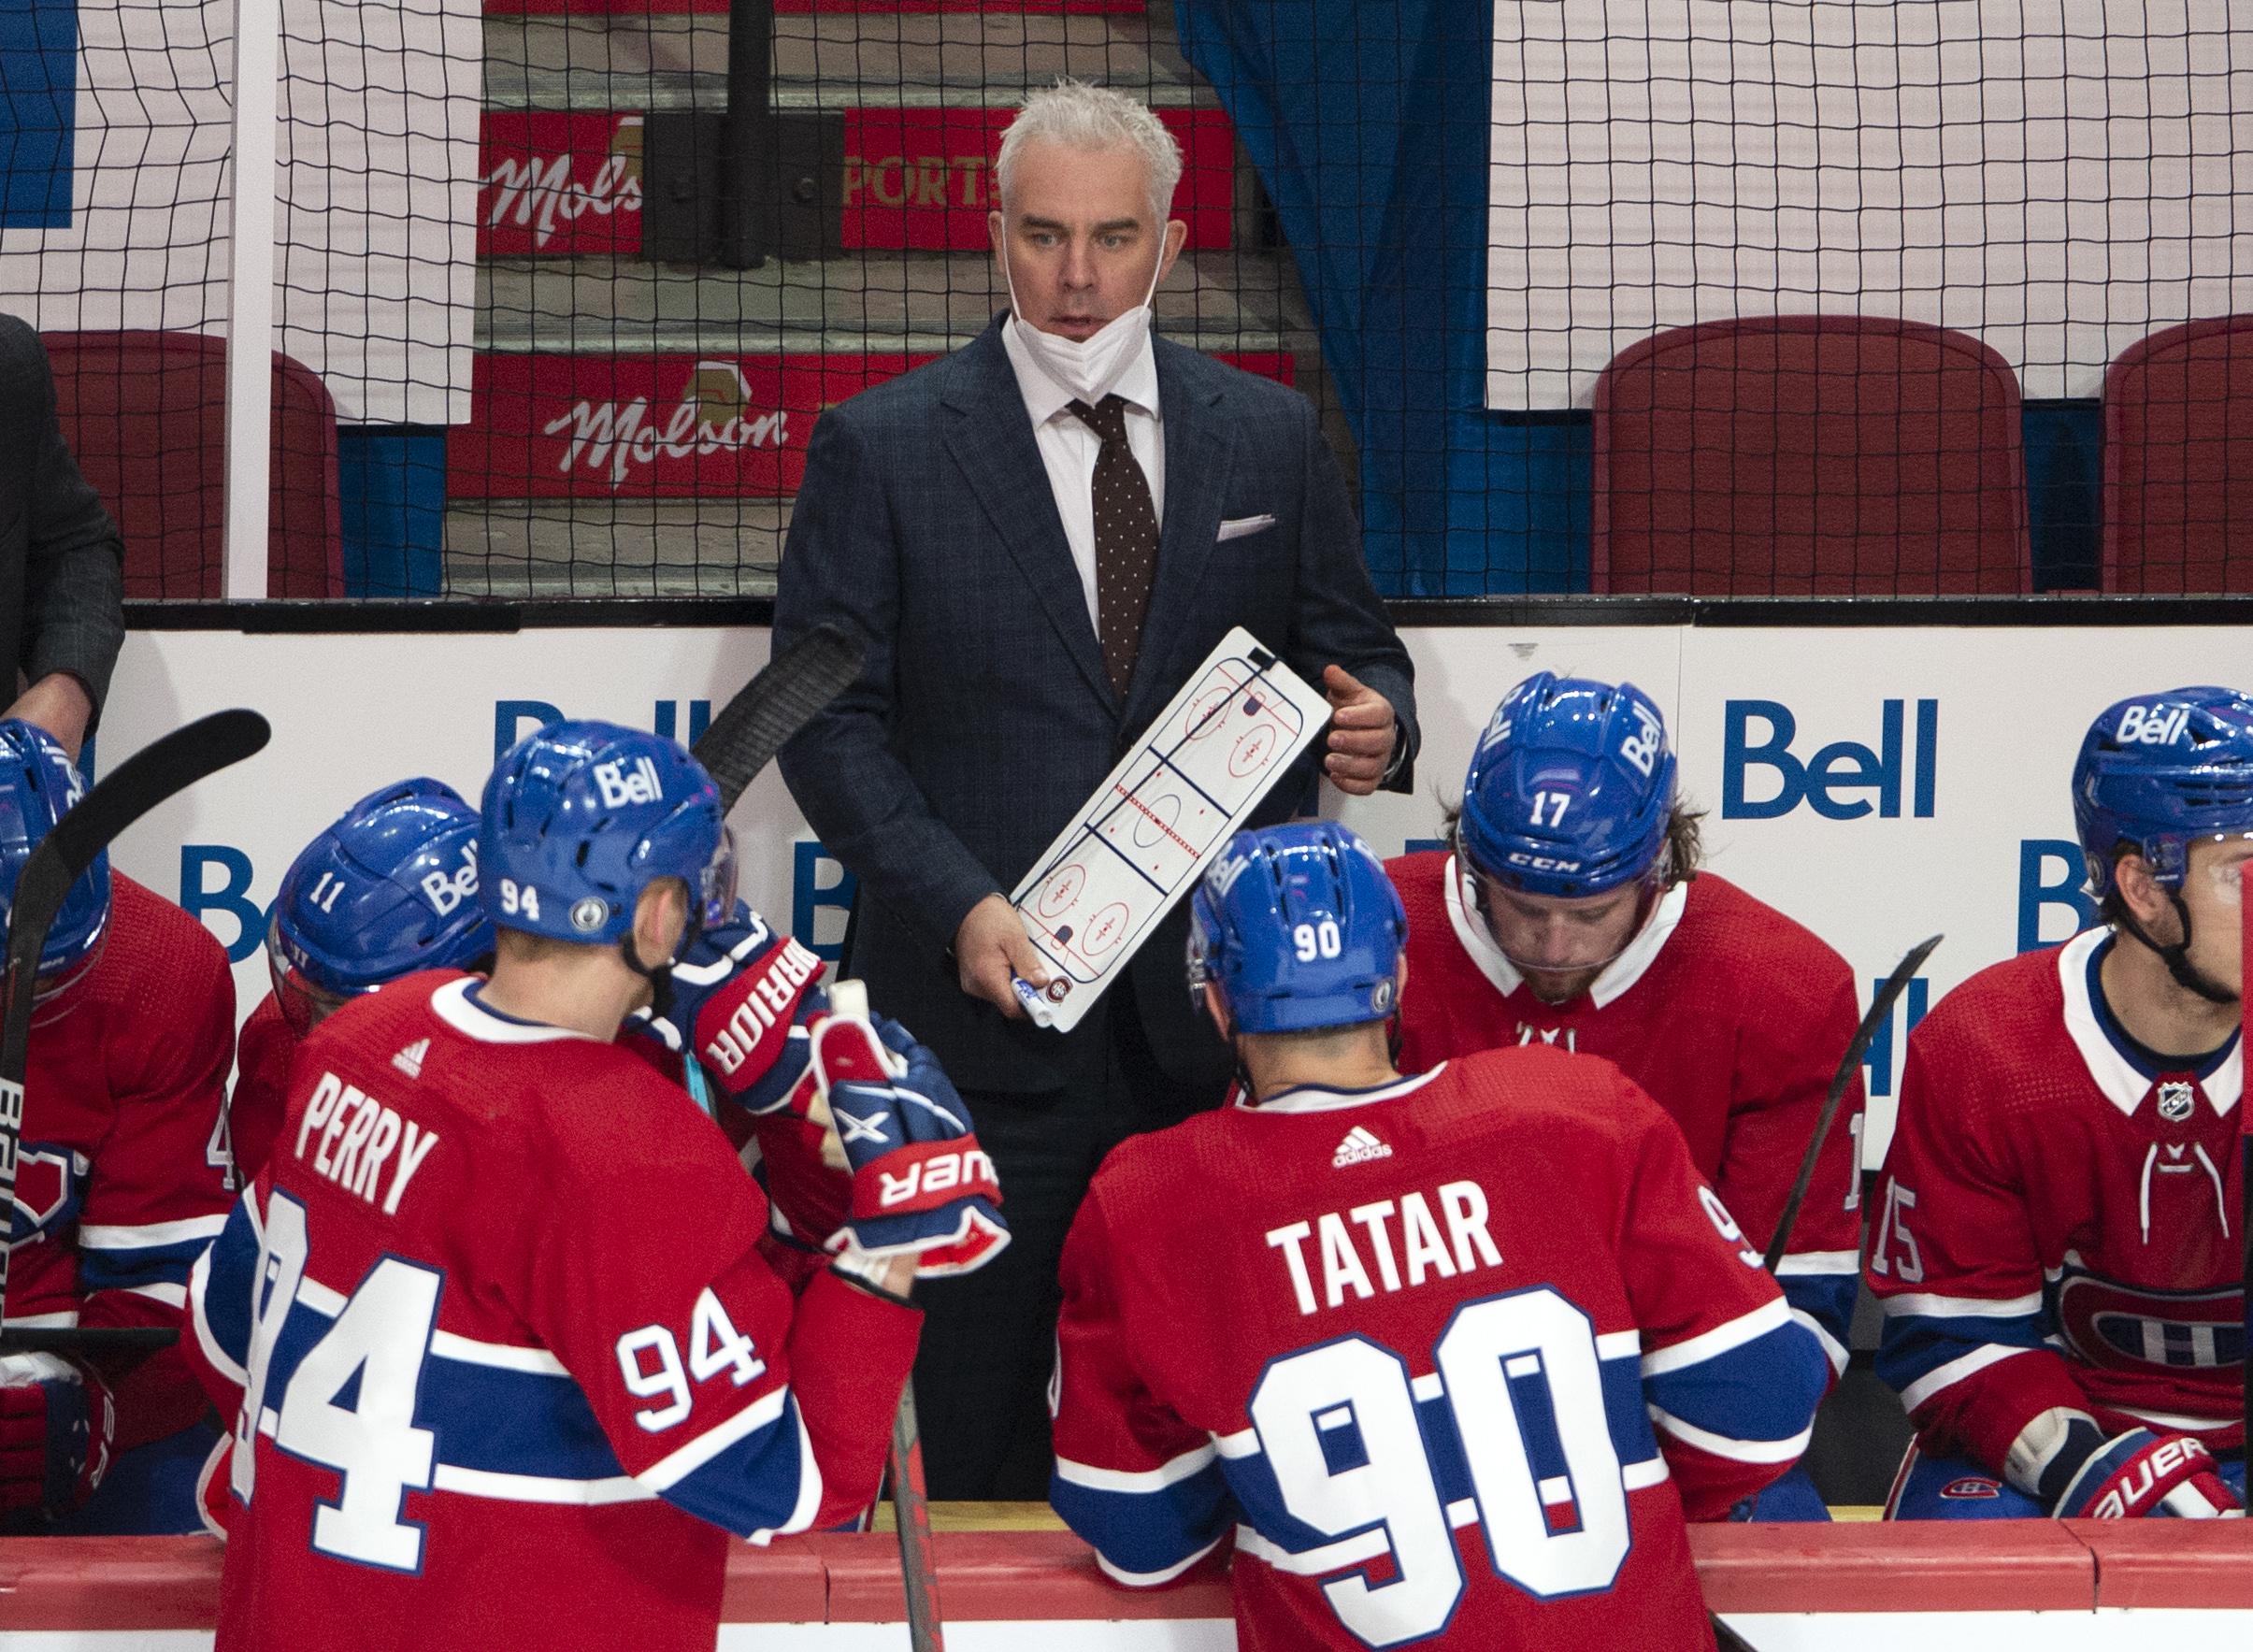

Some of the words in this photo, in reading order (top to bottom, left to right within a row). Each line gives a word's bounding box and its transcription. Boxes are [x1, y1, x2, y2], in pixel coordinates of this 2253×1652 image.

[545, 395, 789, 492] Molson
[1621, 700, 1662, 778] Bell
[1722, 698, 1939, 821] Bell
[2117, 706, 2190, 745] Bell
[592, 755, 664, 809] Bell
[1529, 790, 1571, 828] 17
[309, 870, 347, 914] 11
[499, 878, 540, 921] 94
[1508, 852, 1580, 874] CCM
[1294, 920, 1342, 962] 90
[294, 1071, 439, 1215] PERRY
[1331, 1143, 1393, 1170] adidas
[1266, 1180, 1503, 1315] TATAR
[1872, 1176, 1925, 1284] 15
[230, 1184, 447, 1576] 94
[615, 1285, 768, 1434] 94
[1245, 1282, 1631, 1651] 90
